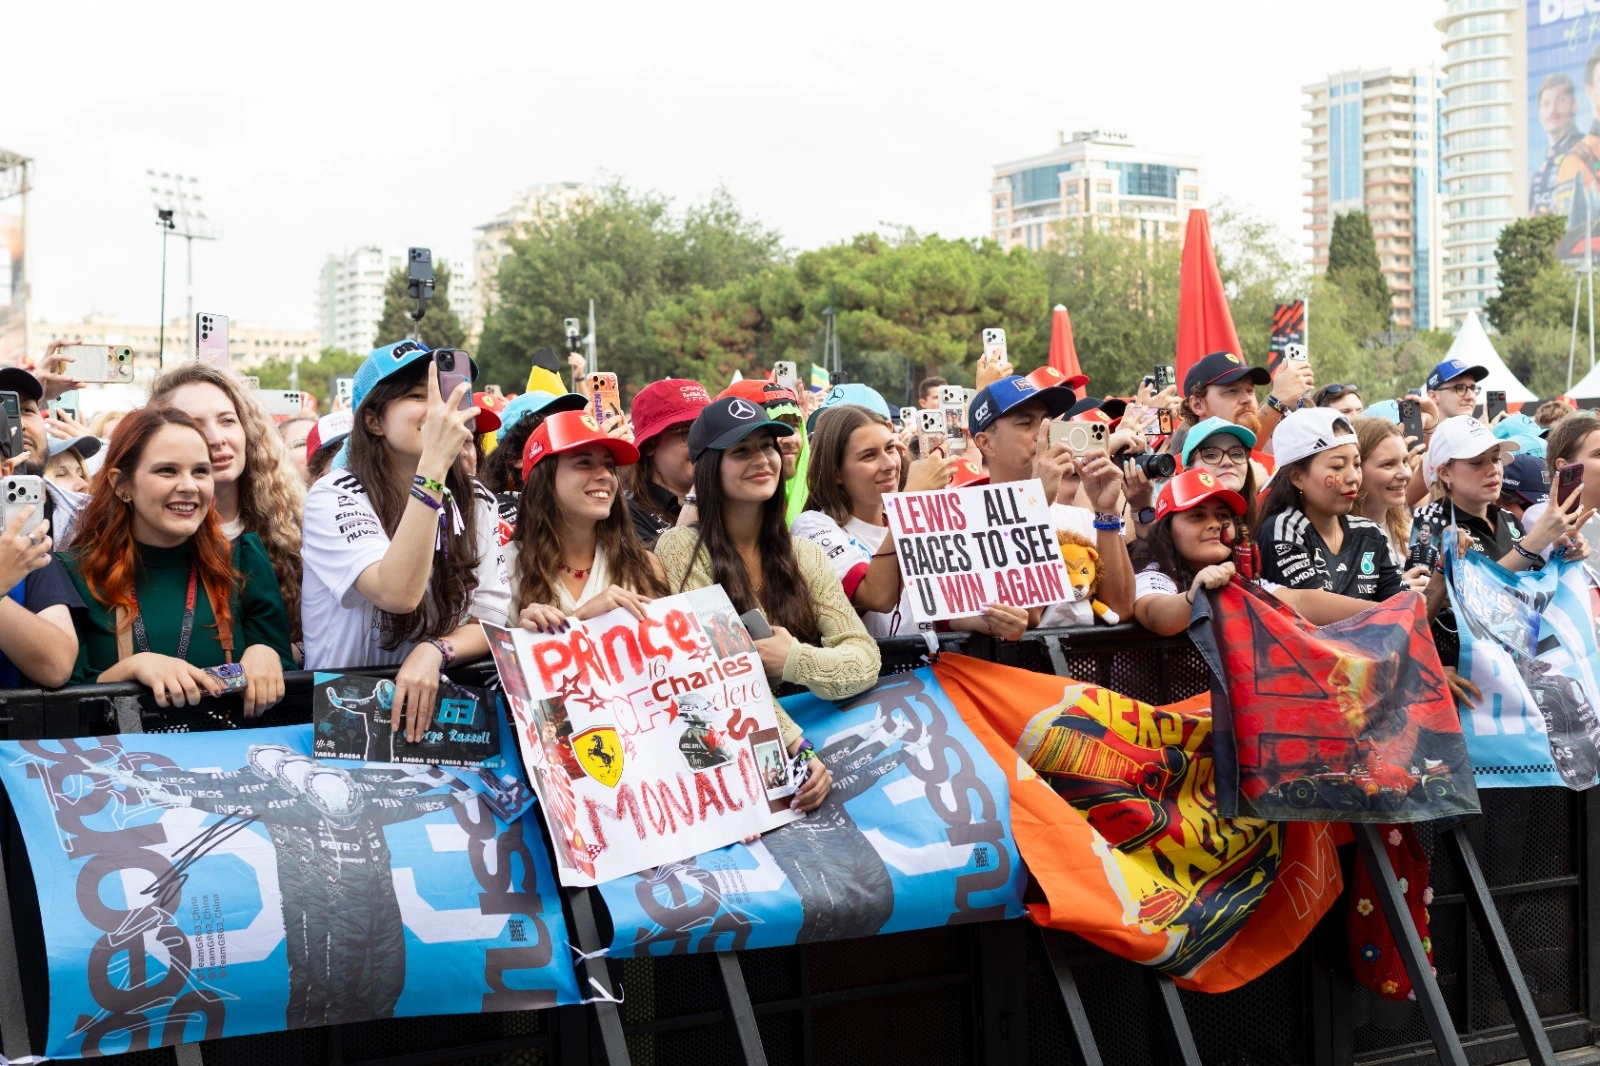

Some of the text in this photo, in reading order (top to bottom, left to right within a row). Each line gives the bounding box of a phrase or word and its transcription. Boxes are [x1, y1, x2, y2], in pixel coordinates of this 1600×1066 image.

[1325, 474, 1342, 488] GR
[894, 487, 1027, 534] LEWIS ALL
[898, 524, 1059, 576] RACES TO SEE
[916, 563, 1066, 616] U WIN AGAIN
[651, 655, 753, 702] Charles
[448, 728, 491, 744] Russell
[823, 747, 850, 765] INEOS
[845, 753, 873, 771] INEOS
[870, 760, 898, 777] INEOS
[363, 774, 394, 783] INEOS
[184, 789, 224, 799] INEOS
[388, 787, 419, 797] INEOS
[584, 748, 760, 851] MONACO
[214, 804, 253, 815] INEOS
[416, 801, 445, 812] INEOS
[191, 896, 206, 981] @TeamGR63_China
[203, 894, 216, 980] @TeamGR63_China
[213, 893, 227, 979] @TeamGR63_China
